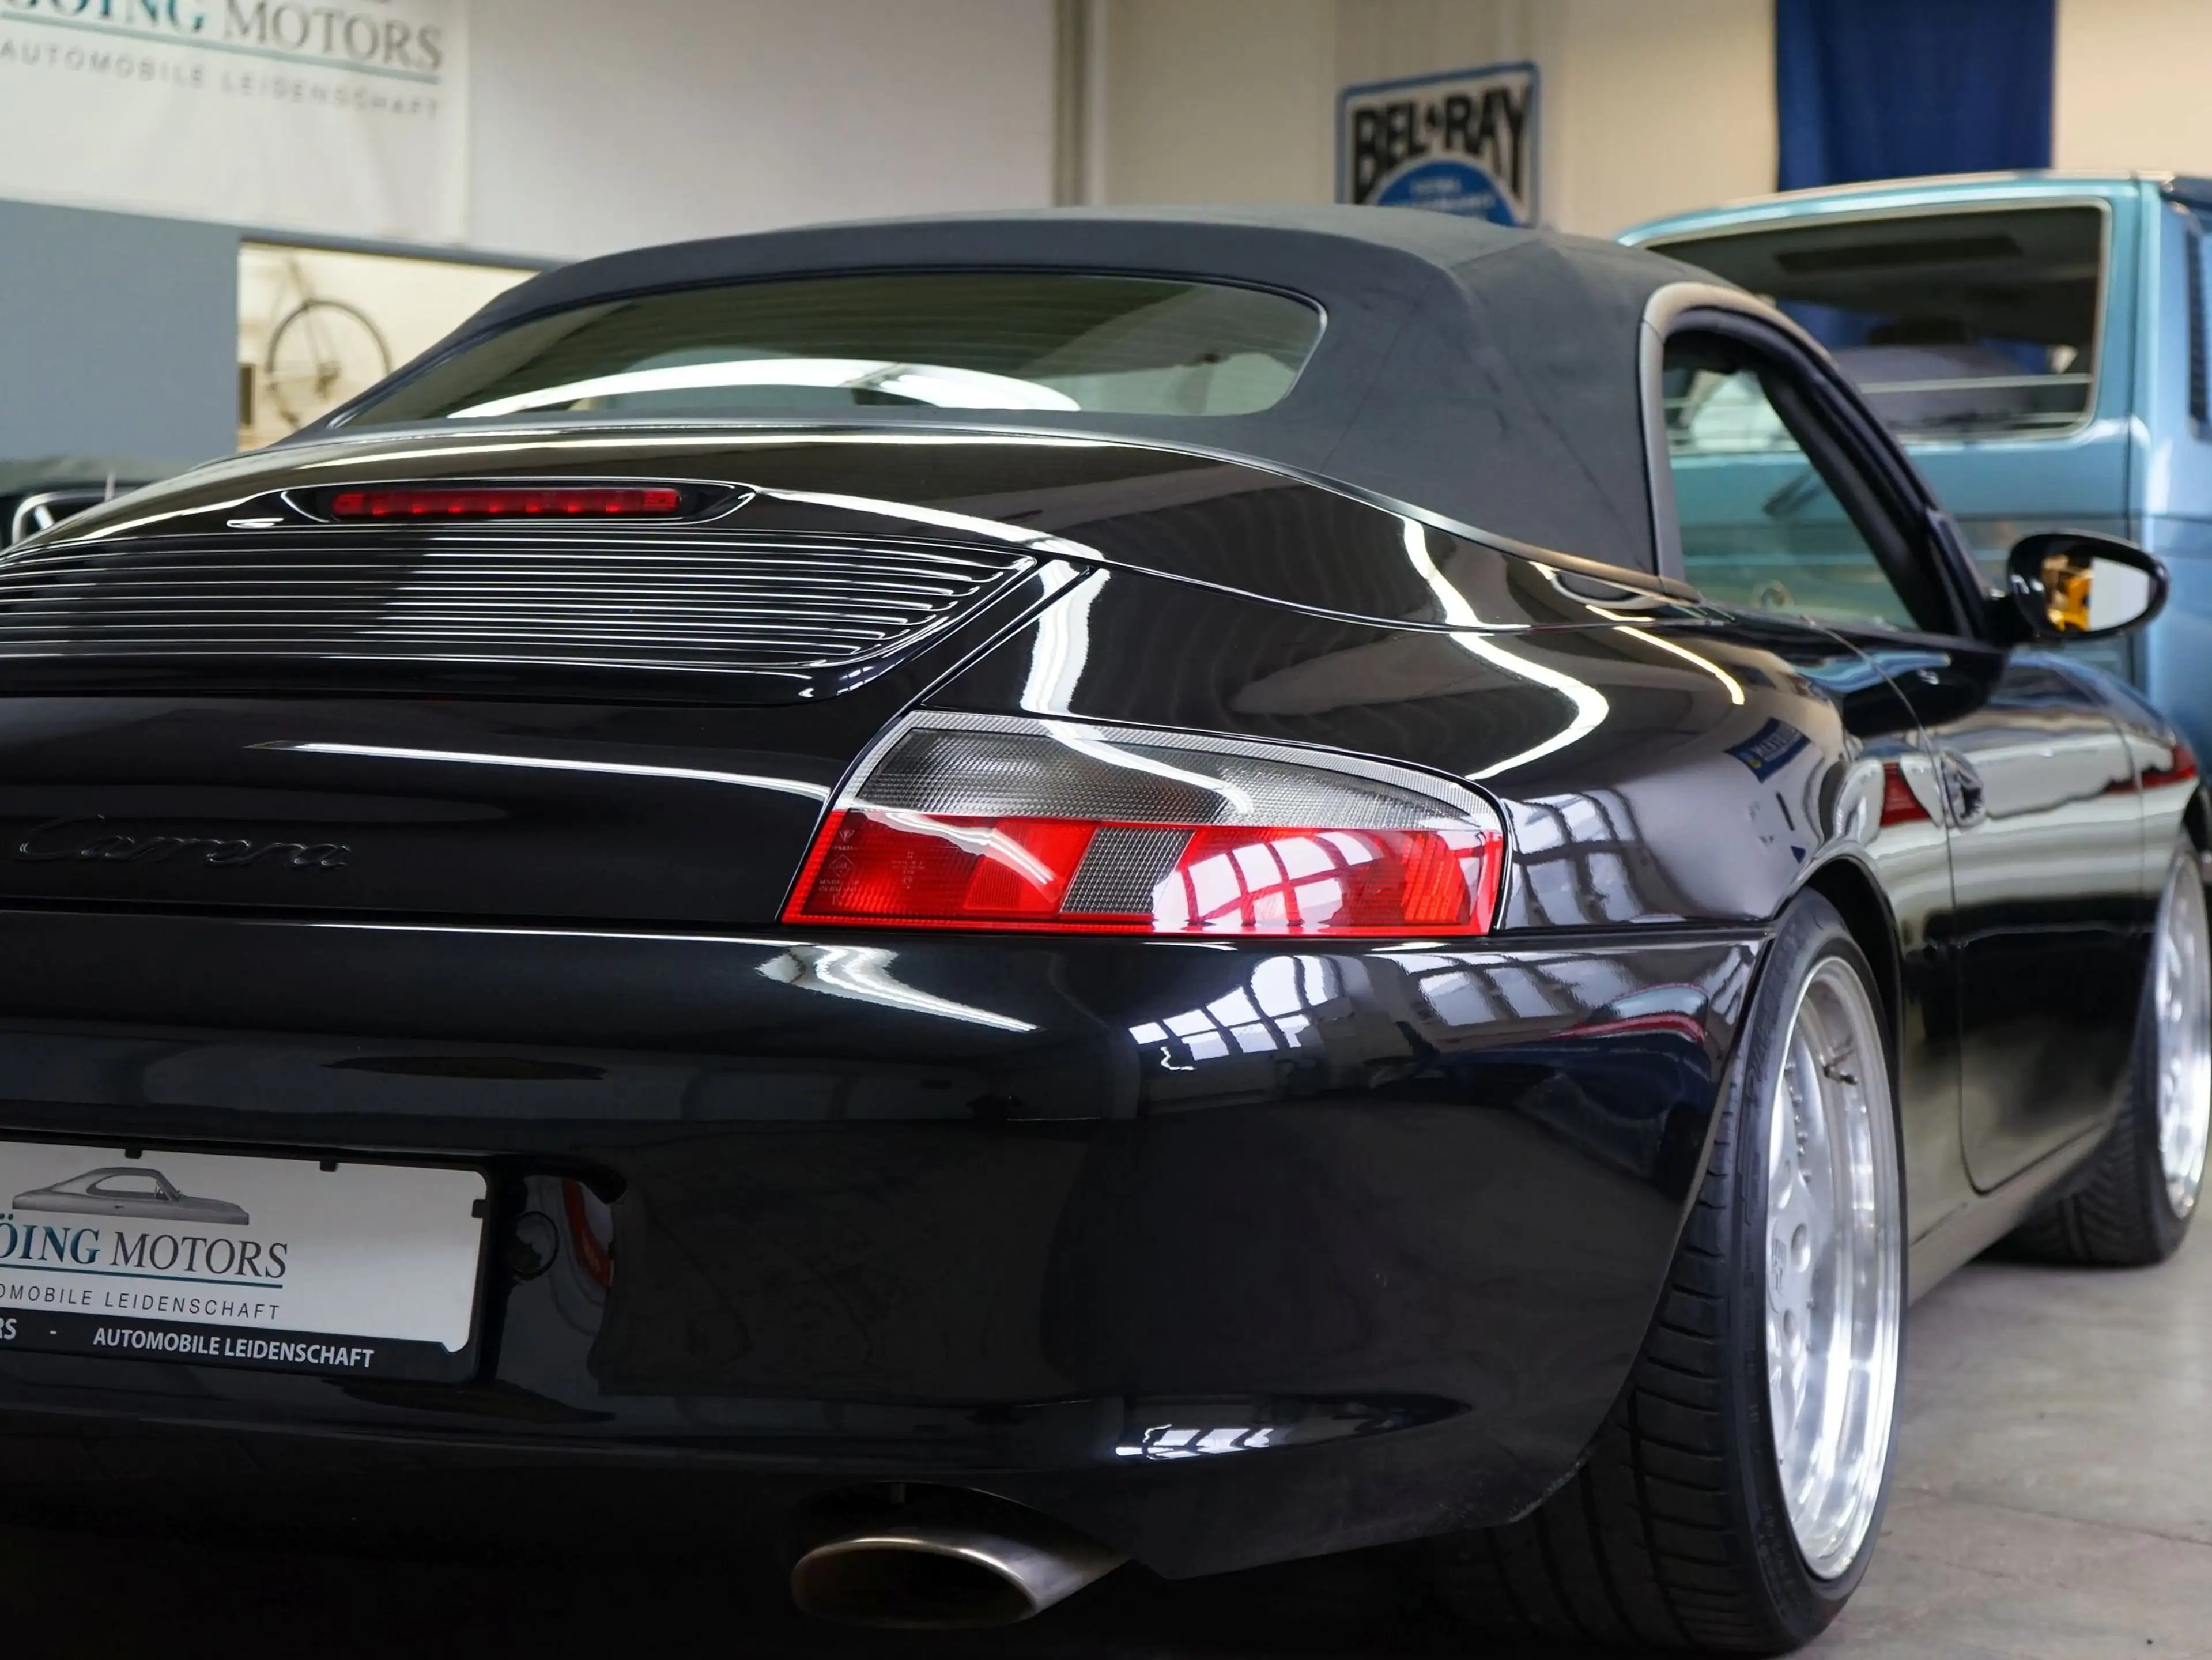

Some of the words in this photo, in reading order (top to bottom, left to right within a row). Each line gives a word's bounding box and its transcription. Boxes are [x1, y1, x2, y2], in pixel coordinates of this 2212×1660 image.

[224, 0, 444, 70] MOTORS
[0, 38, 205, 89] AUTOMOBILE
[220, 69, 440, 120] LEIDENSCHAFT
[14, 814, 352, 866] Carrera
[110, 1231, 288, 1278] MOTORS
[104, 1292, 280, 1320] LEIDENSCHAFT
[93, 1327, 220, 1355] AUTOMOBILE
[224, 1337, 375, 1368] LEIDENSCHAFT
